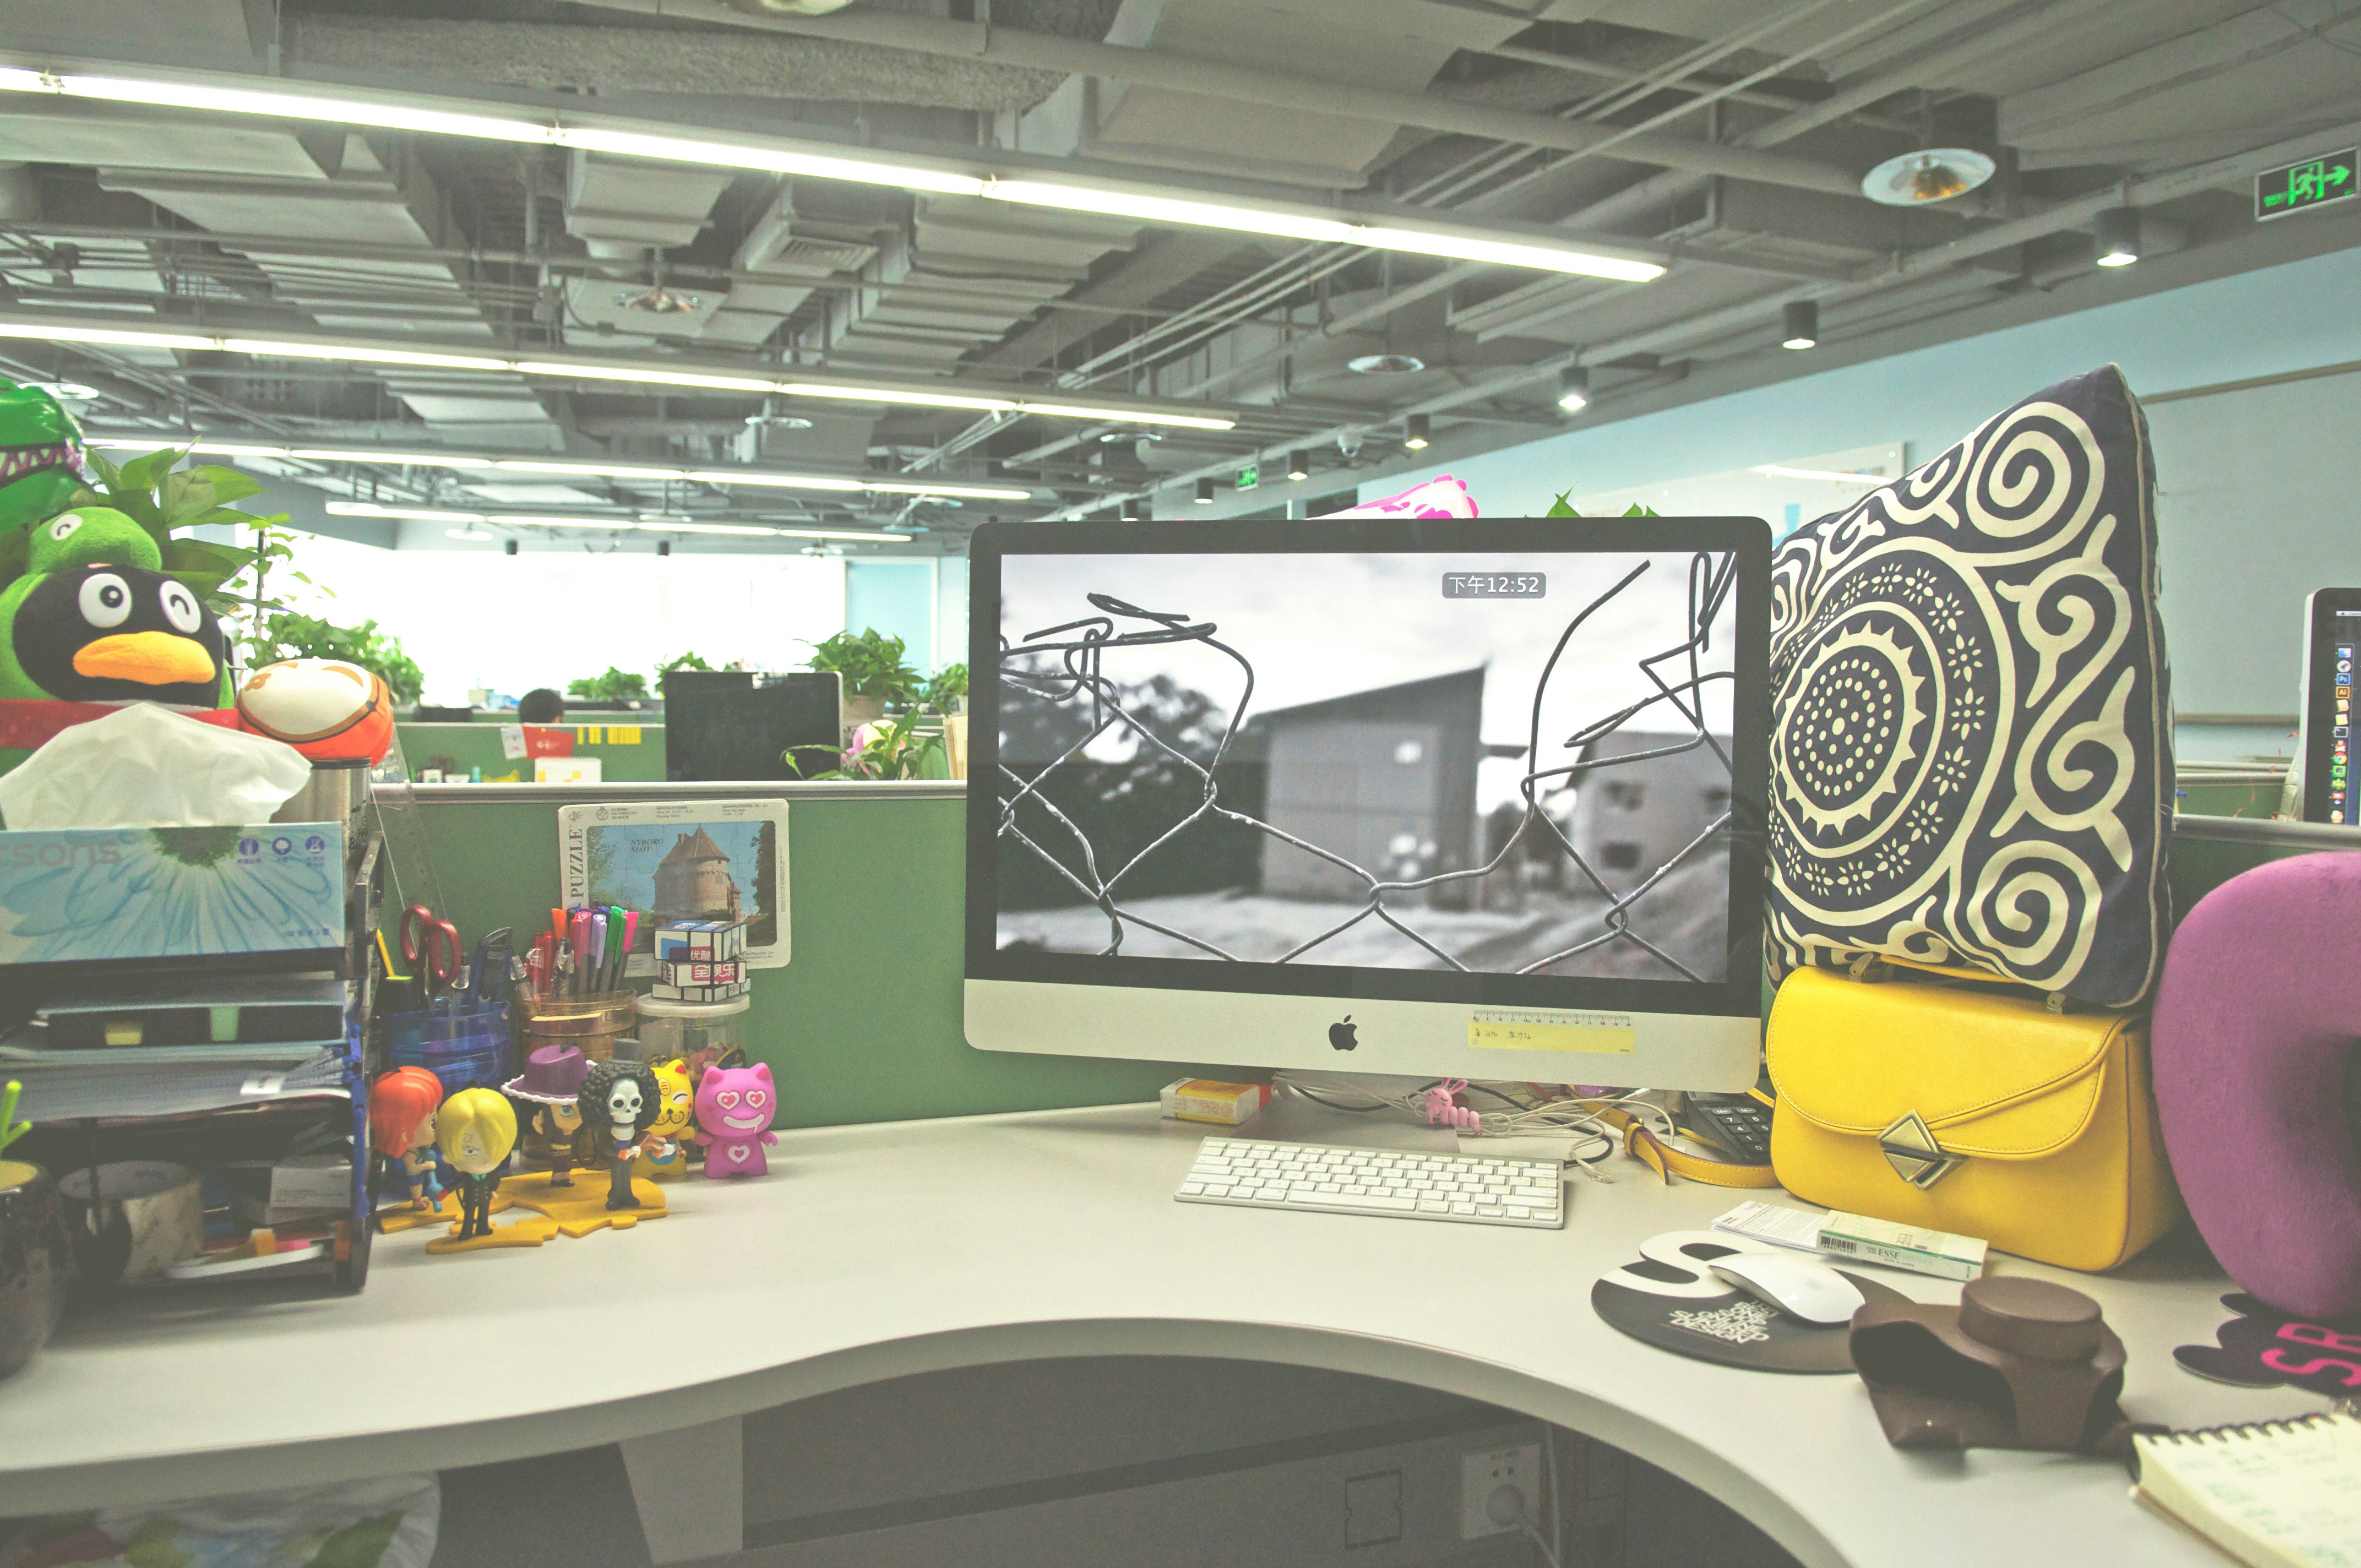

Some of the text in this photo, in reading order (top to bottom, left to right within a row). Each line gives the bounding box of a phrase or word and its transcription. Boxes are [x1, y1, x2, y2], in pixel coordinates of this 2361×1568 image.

[1449, 575, 1539, 595] 下午12:52
[569, 829, 584, 898] PUZZLE
[1878, 1248, 1901, 1260] ESSE
